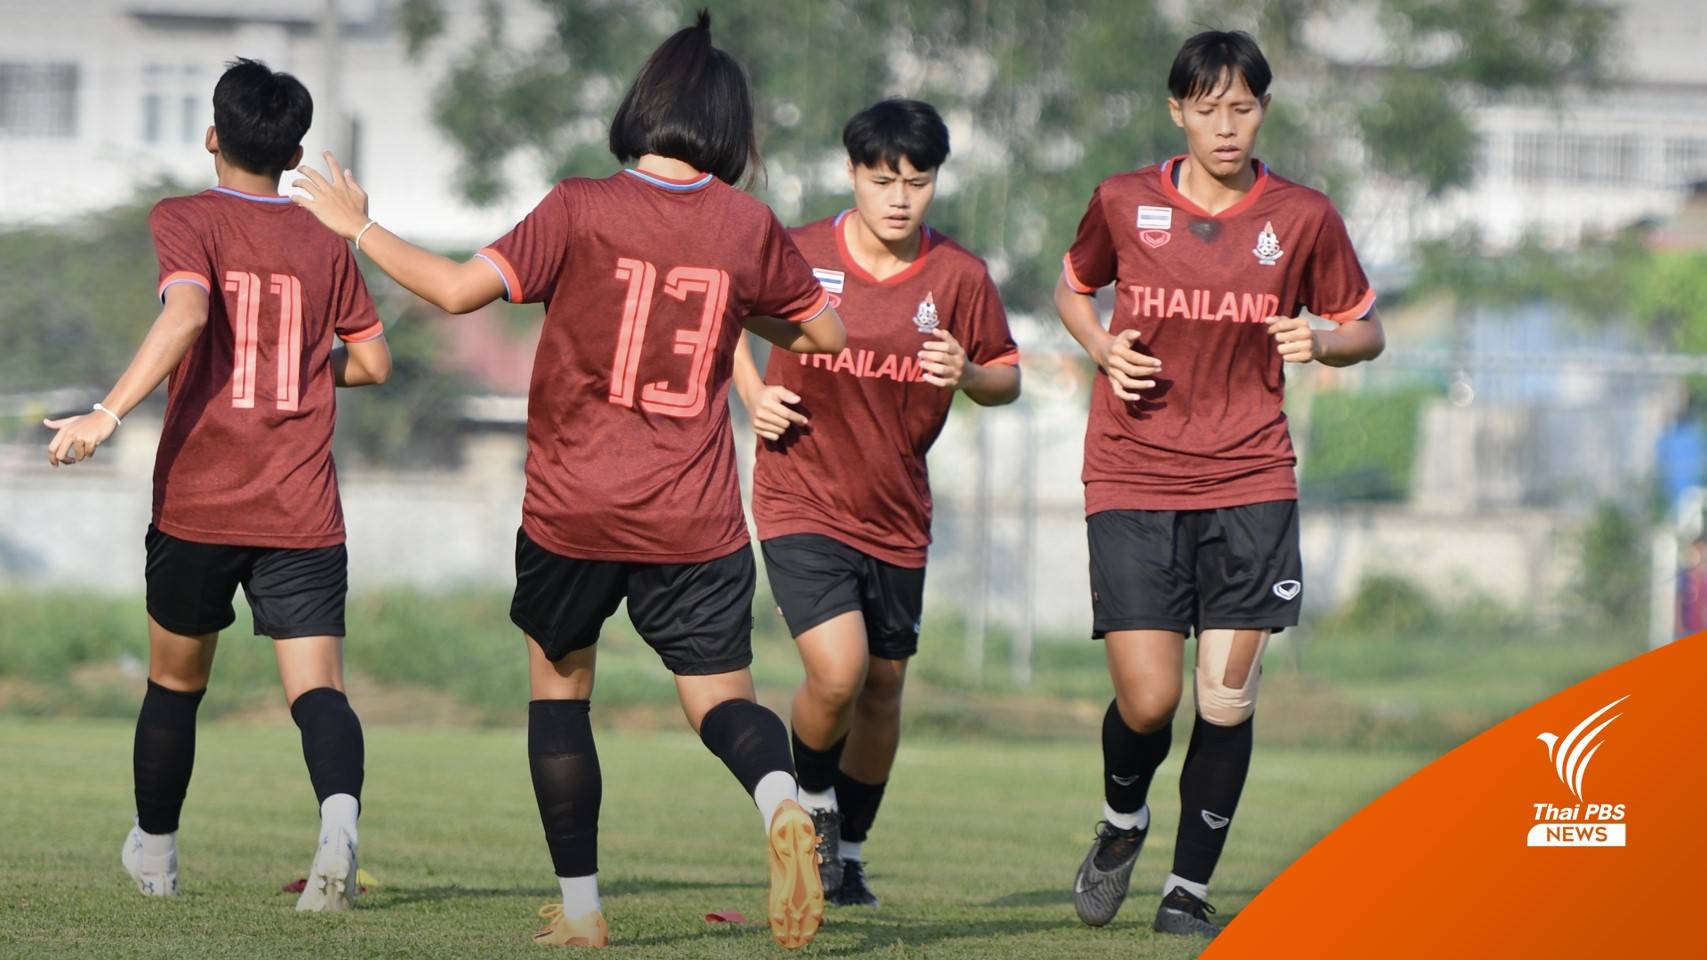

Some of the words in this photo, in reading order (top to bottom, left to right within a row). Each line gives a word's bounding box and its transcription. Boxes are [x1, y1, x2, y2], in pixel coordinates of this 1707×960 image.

[225, 270, 302, 411] 11
[609, 257, 730, 418] 13
[1129, 285, 1280, 323] THAILAND
